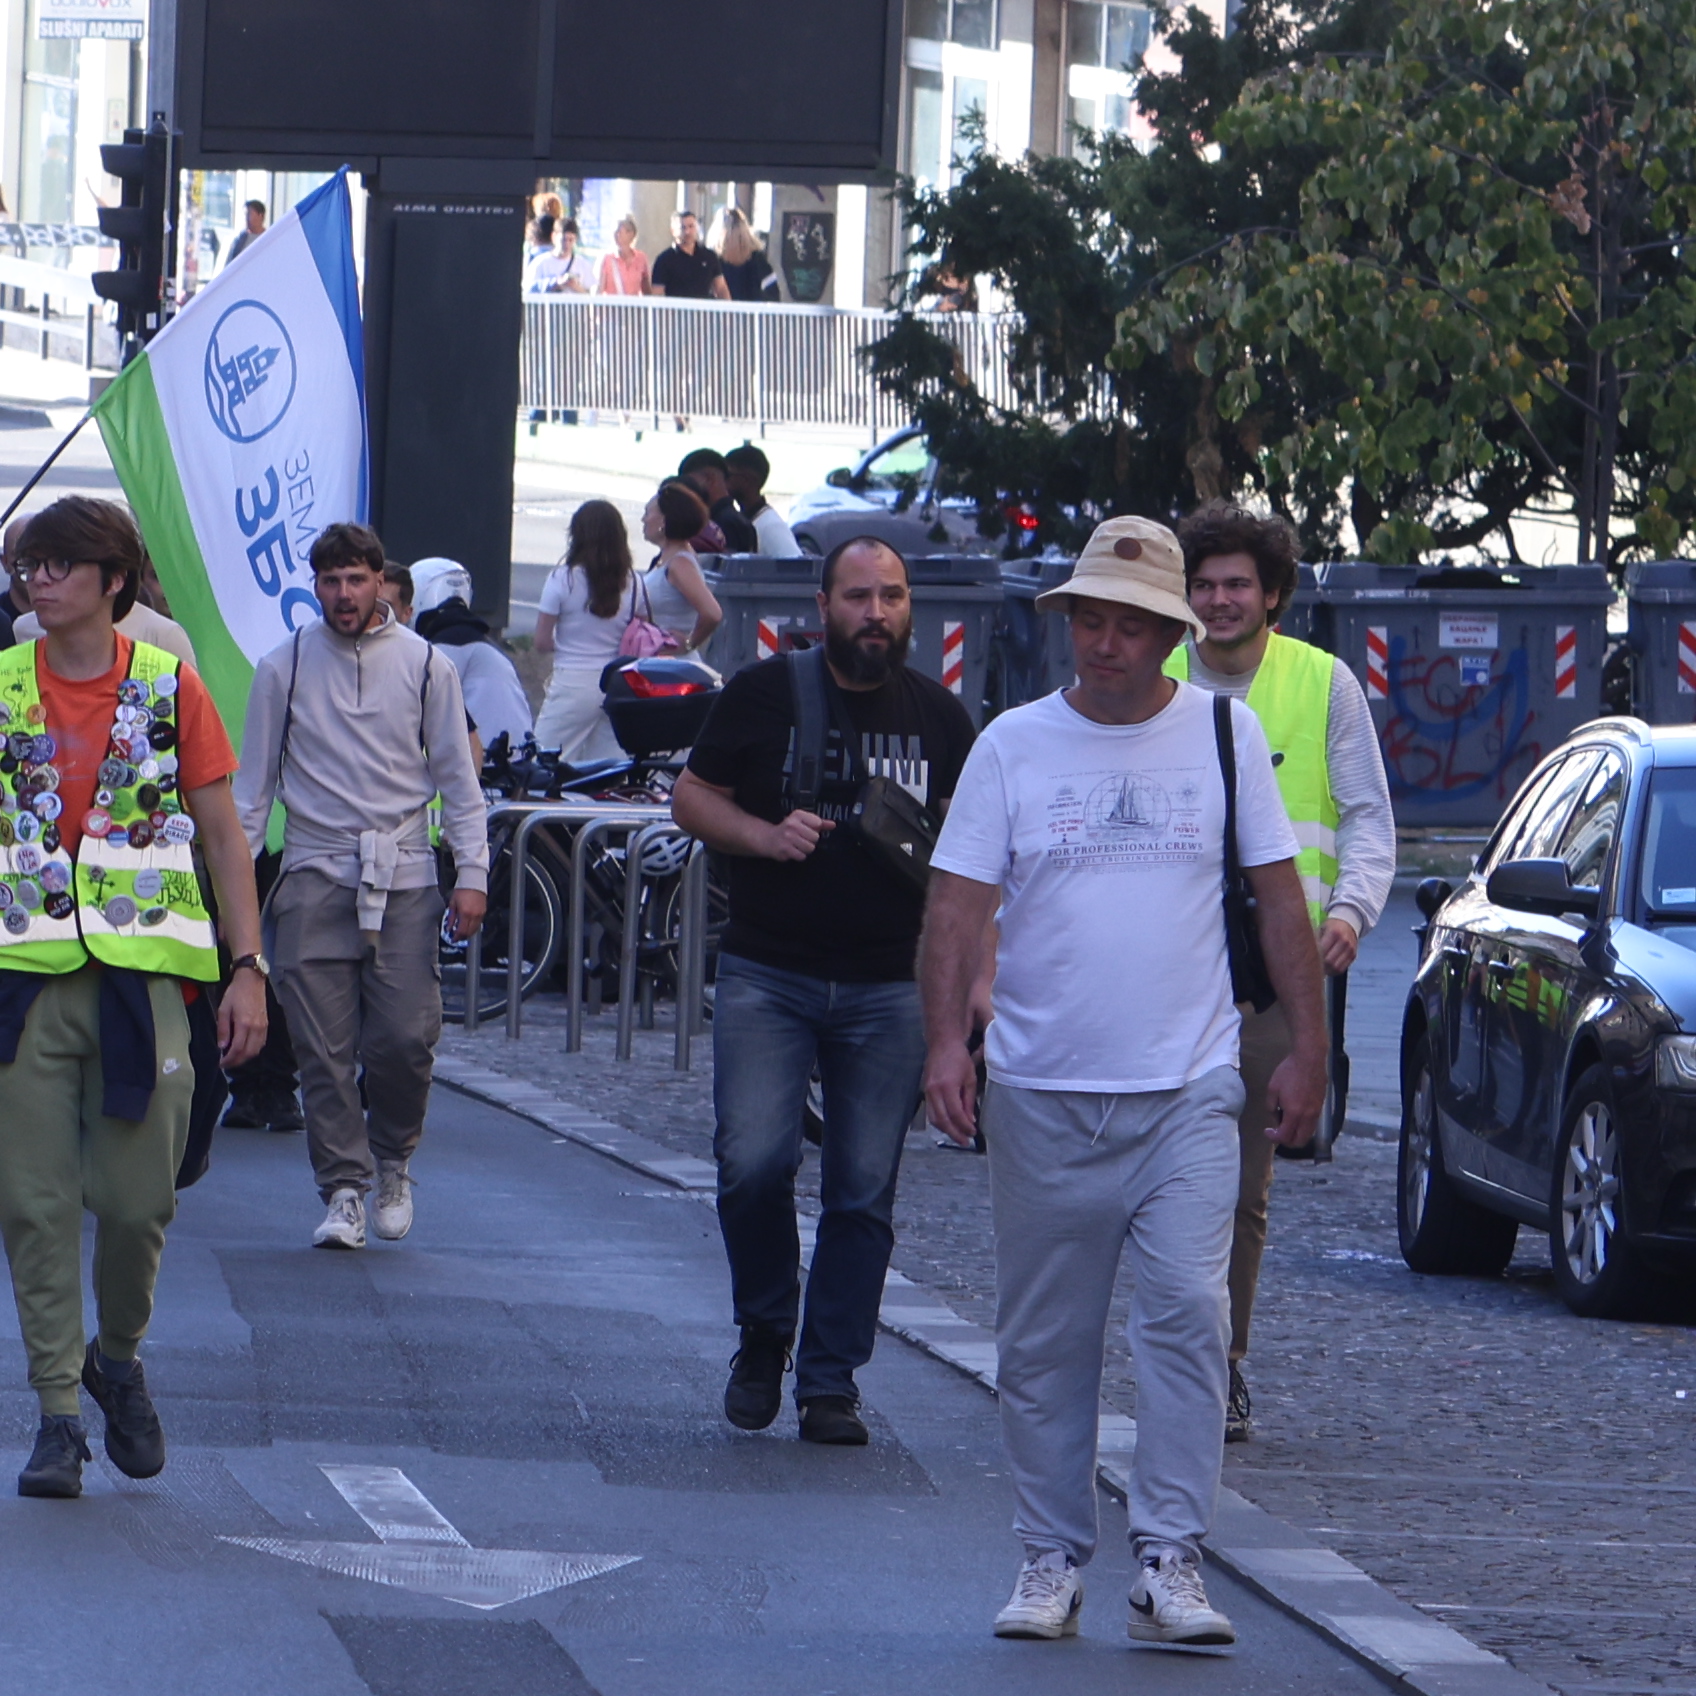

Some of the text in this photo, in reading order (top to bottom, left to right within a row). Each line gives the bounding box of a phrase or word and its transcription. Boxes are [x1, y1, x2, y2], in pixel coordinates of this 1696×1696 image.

[39, 19, 143, 39] SLUŠNI APARATI
[442, 205, 514, 215] QUATTRO
[1048, 841, 1204, 857] FOR PROFESSIONAL CREWS
